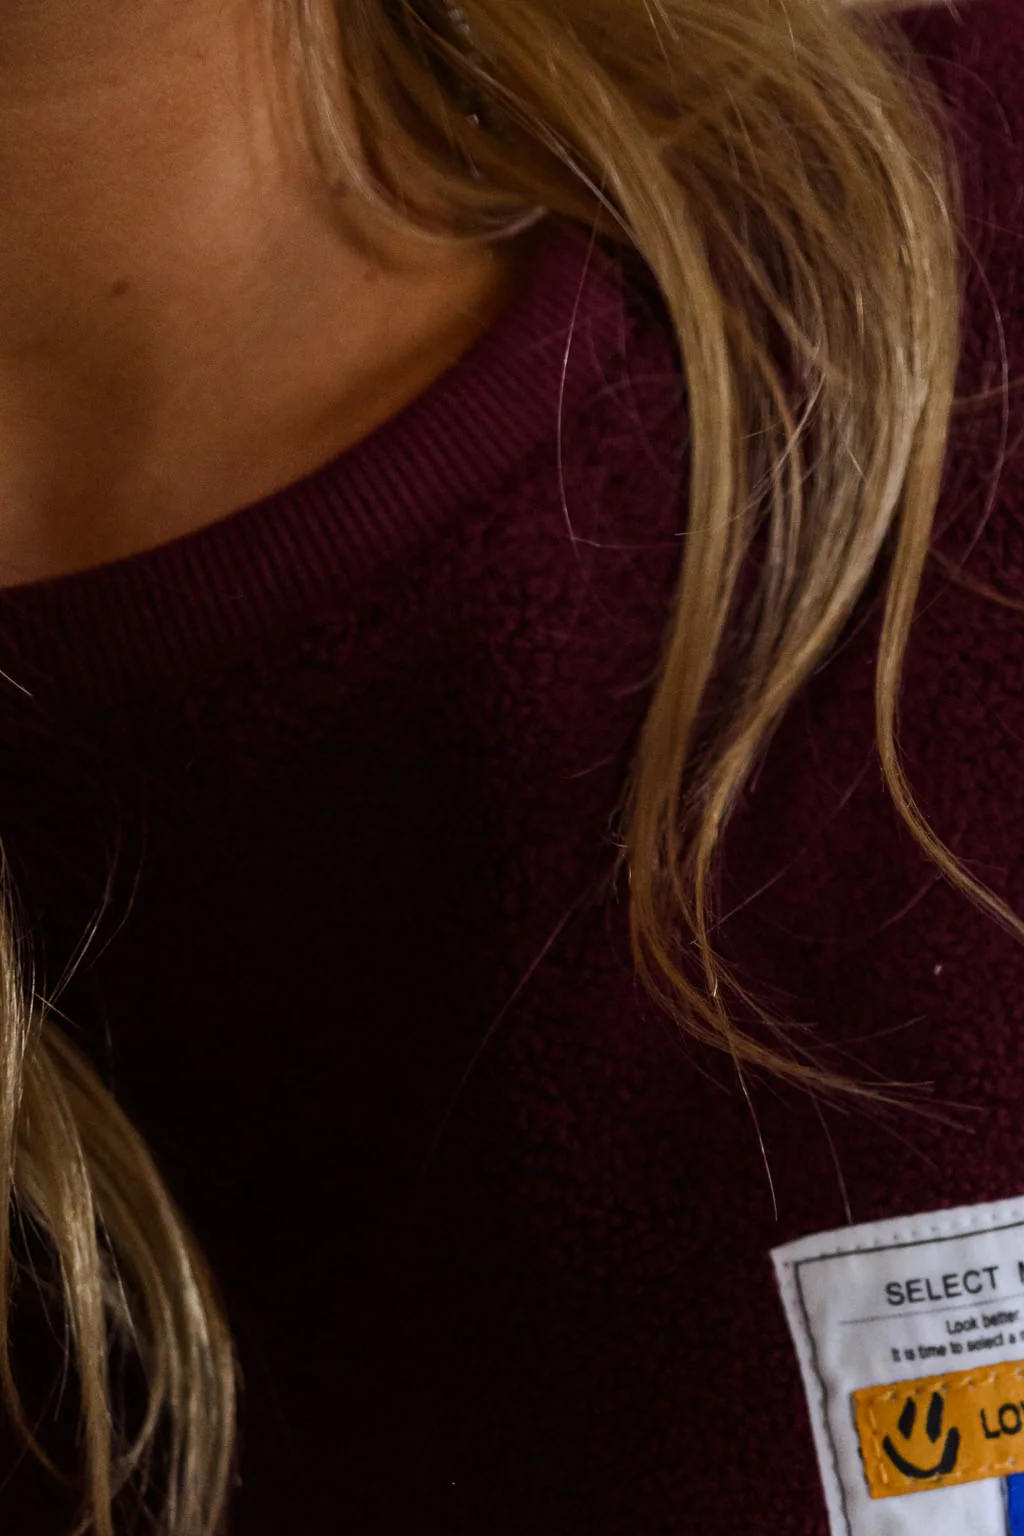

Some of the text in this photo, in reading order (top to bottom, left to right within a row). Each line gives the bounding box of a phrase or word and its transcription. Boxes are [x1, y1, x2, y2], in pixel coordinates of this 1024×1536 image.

[885, 1265, 1000, 1306] SELECT
[945, 1316, 979, 1335] Look
[918, 1343, 946, 1360] time
[950, 1340, 963, 1355] to
[967, 1333, 1005, 1353] select
